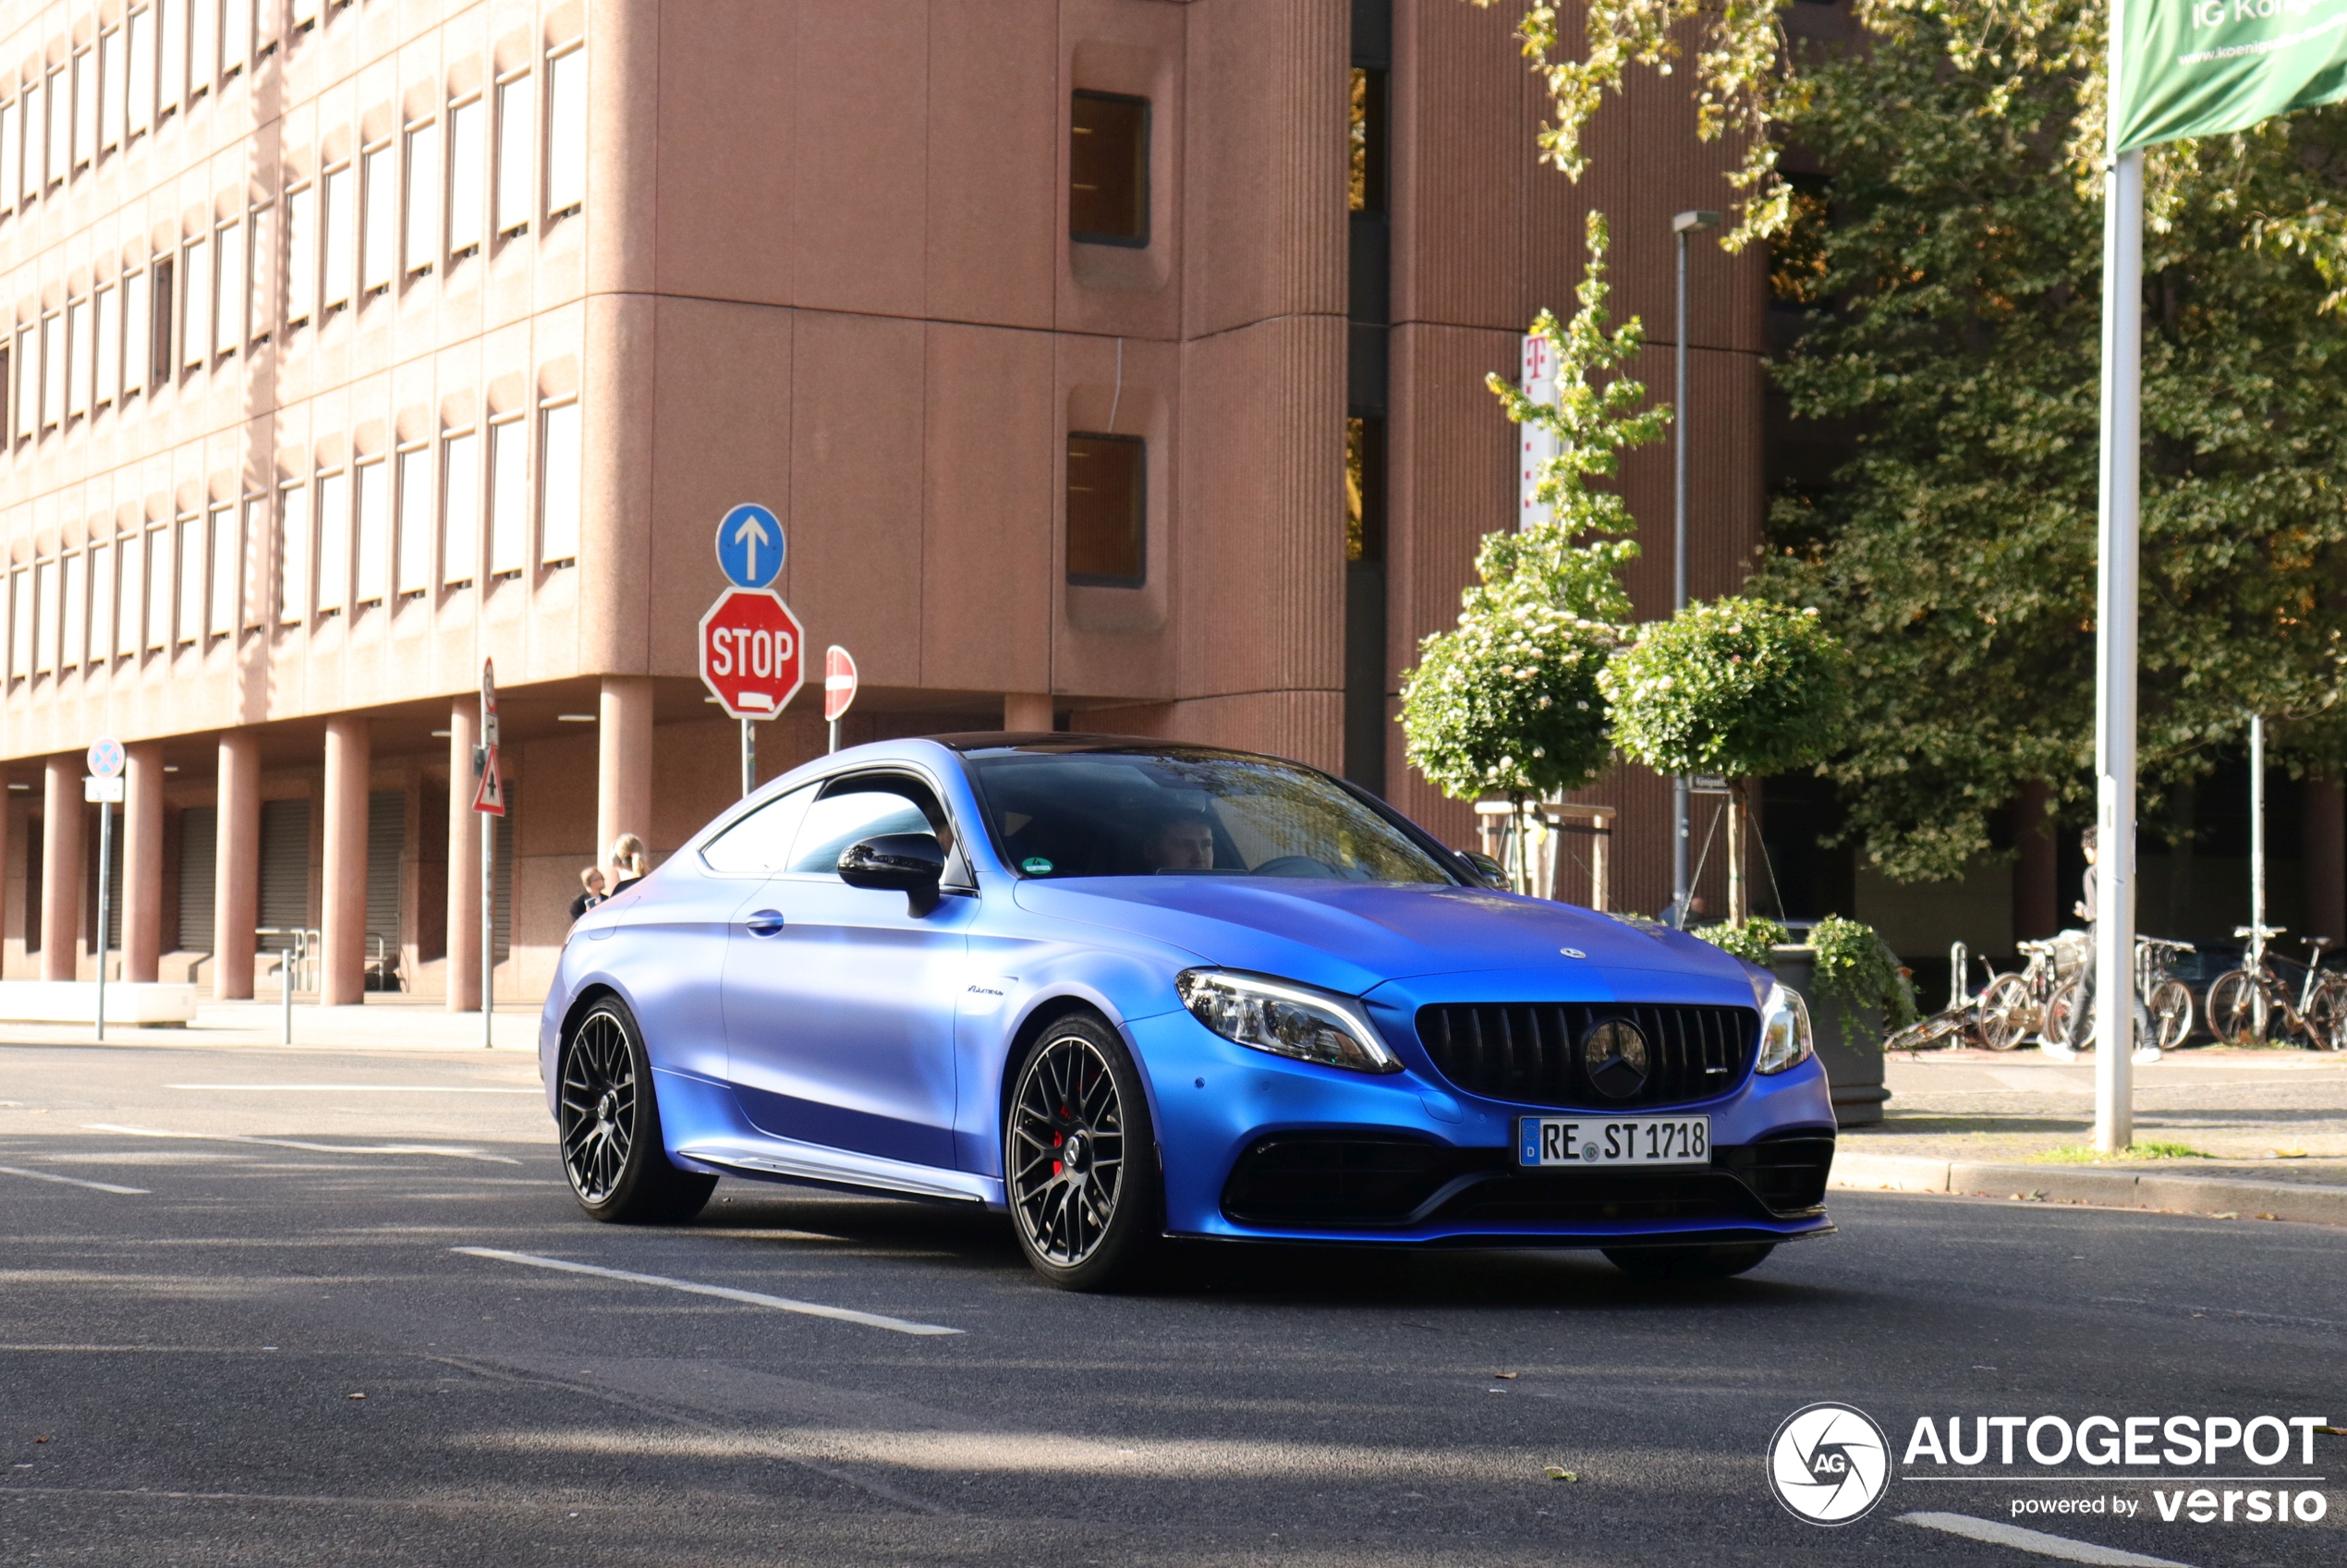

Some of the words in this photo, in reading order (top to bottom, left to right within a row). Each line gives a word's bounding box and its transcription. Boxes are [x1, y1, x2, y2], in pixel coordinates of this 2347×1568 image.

[2193, 0, 2225, 29] IG
[711, 626, 795, 679] STOP
[1526, 1147, 1535, 1158] D
[1542, 1124, 1580, 1160] RE
[1604, 1124, 1638, 1159] ST
[1646, 1122, 1706, 1158] 1718
